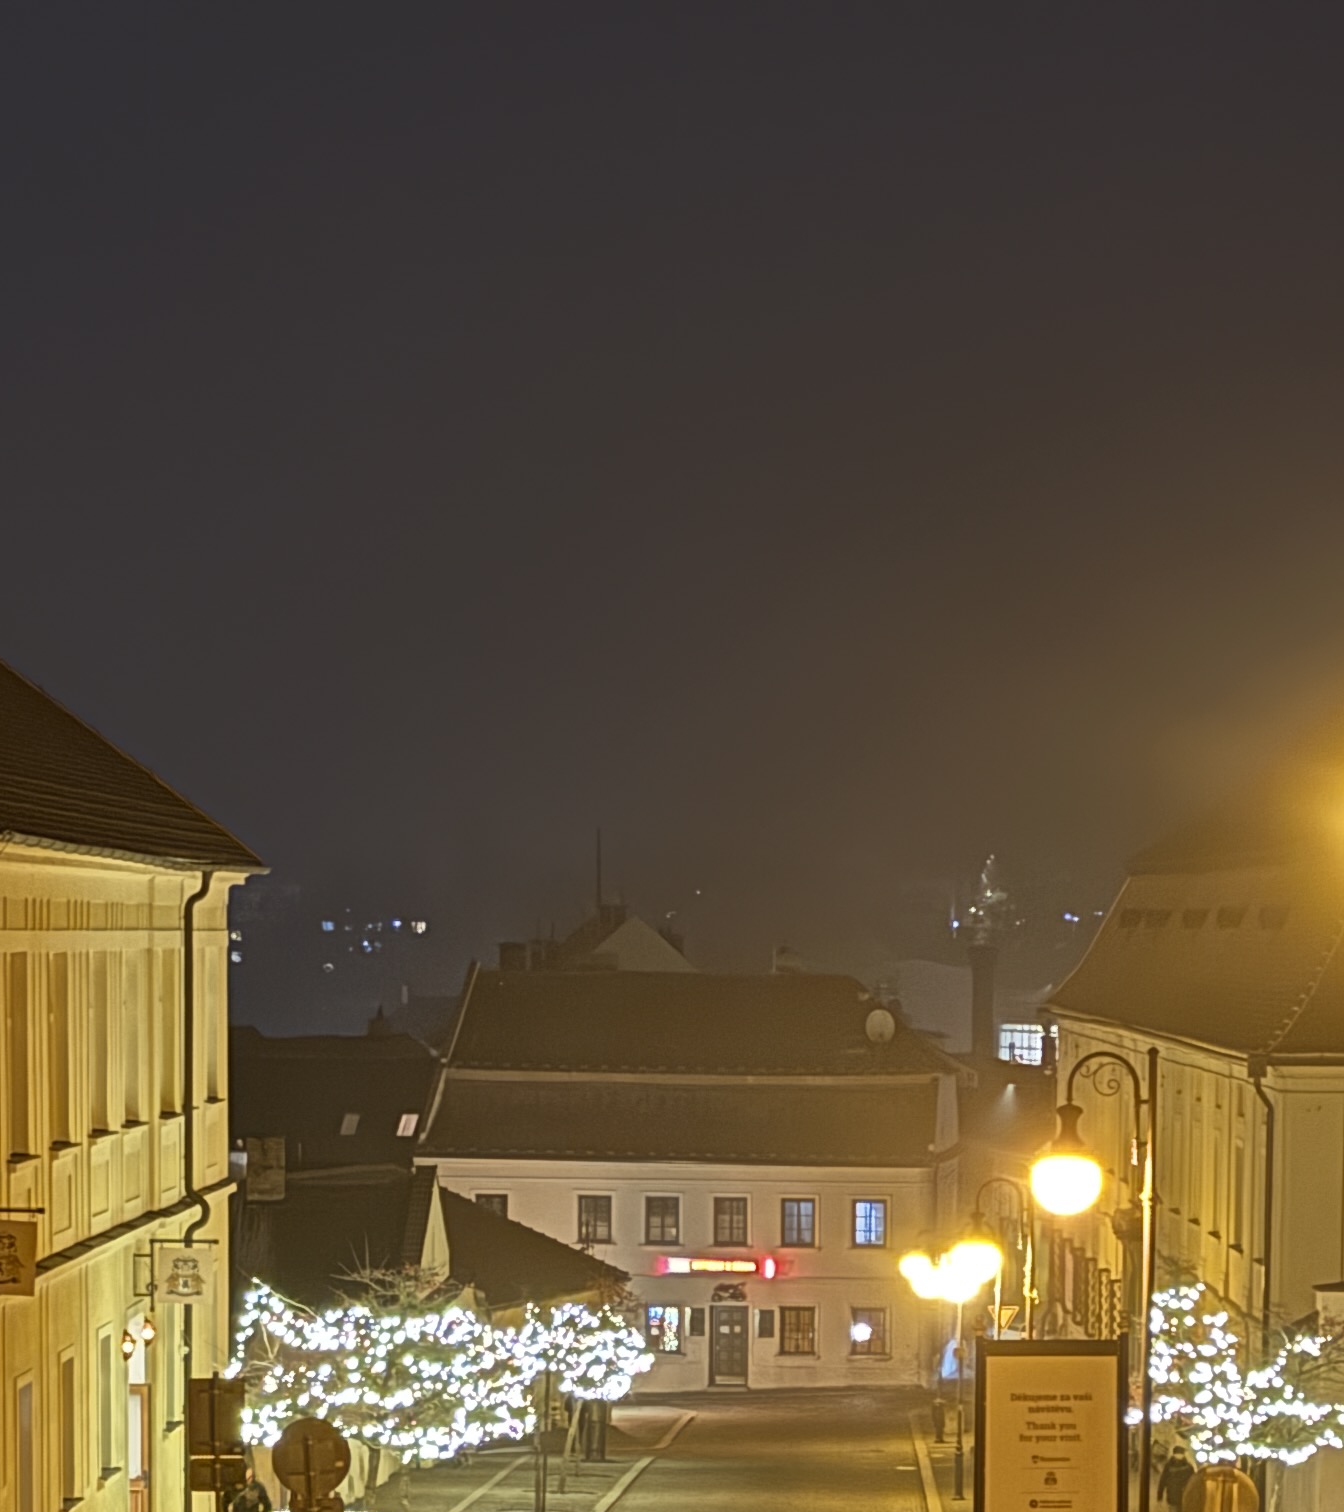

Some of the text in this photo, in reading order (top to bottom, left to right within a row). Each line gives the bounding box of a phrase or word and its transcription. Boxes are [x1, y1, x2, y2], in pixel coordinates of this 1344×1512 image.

[1025, 1421, 1077, 1432] Thank you
[1019, 1433, 1033, 1442] for
[1035, 1435, 1058, 1444] your
